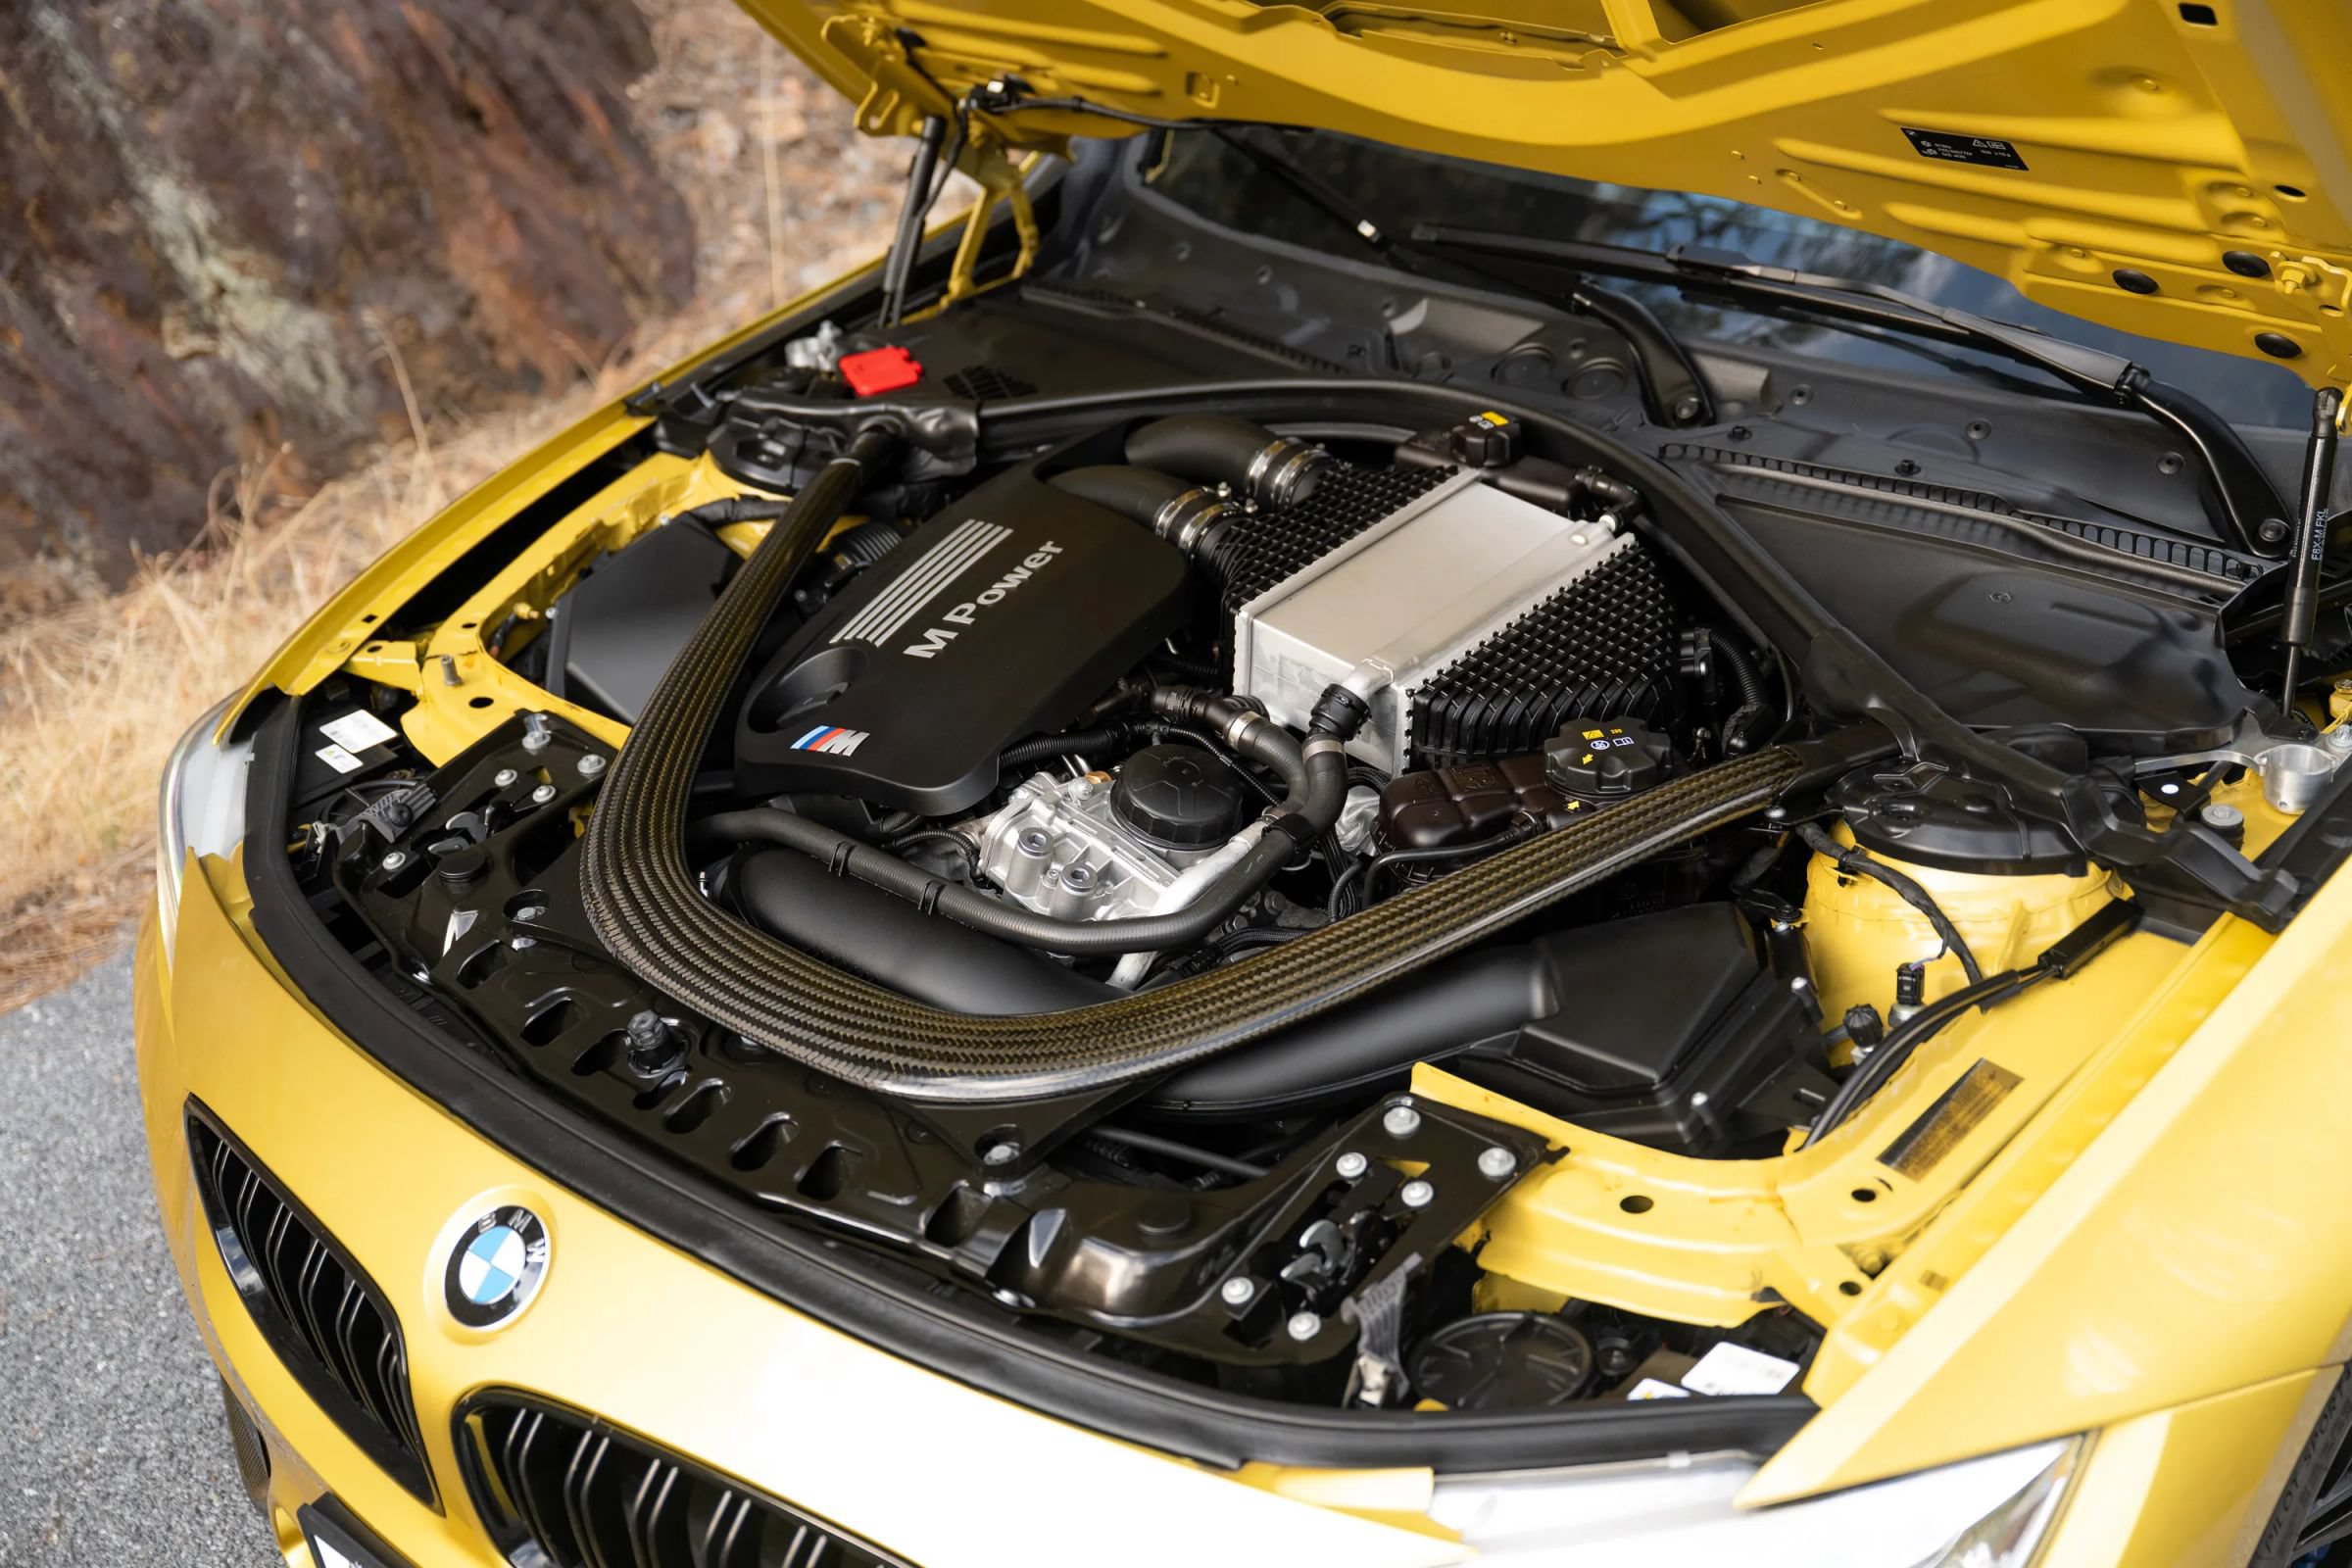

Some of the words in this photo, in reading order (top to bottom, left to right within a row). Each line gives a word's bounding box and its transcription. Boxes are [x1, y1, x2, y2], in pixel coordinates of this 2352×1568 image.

[2316, 509, 2327, 527] FKL
[2311, 529, 2324, 561] F8X-M
[903, 626, 958, 660] M
[943, 540, 1064, 625] Power
[477, 1207, 546, 1263] BMW
